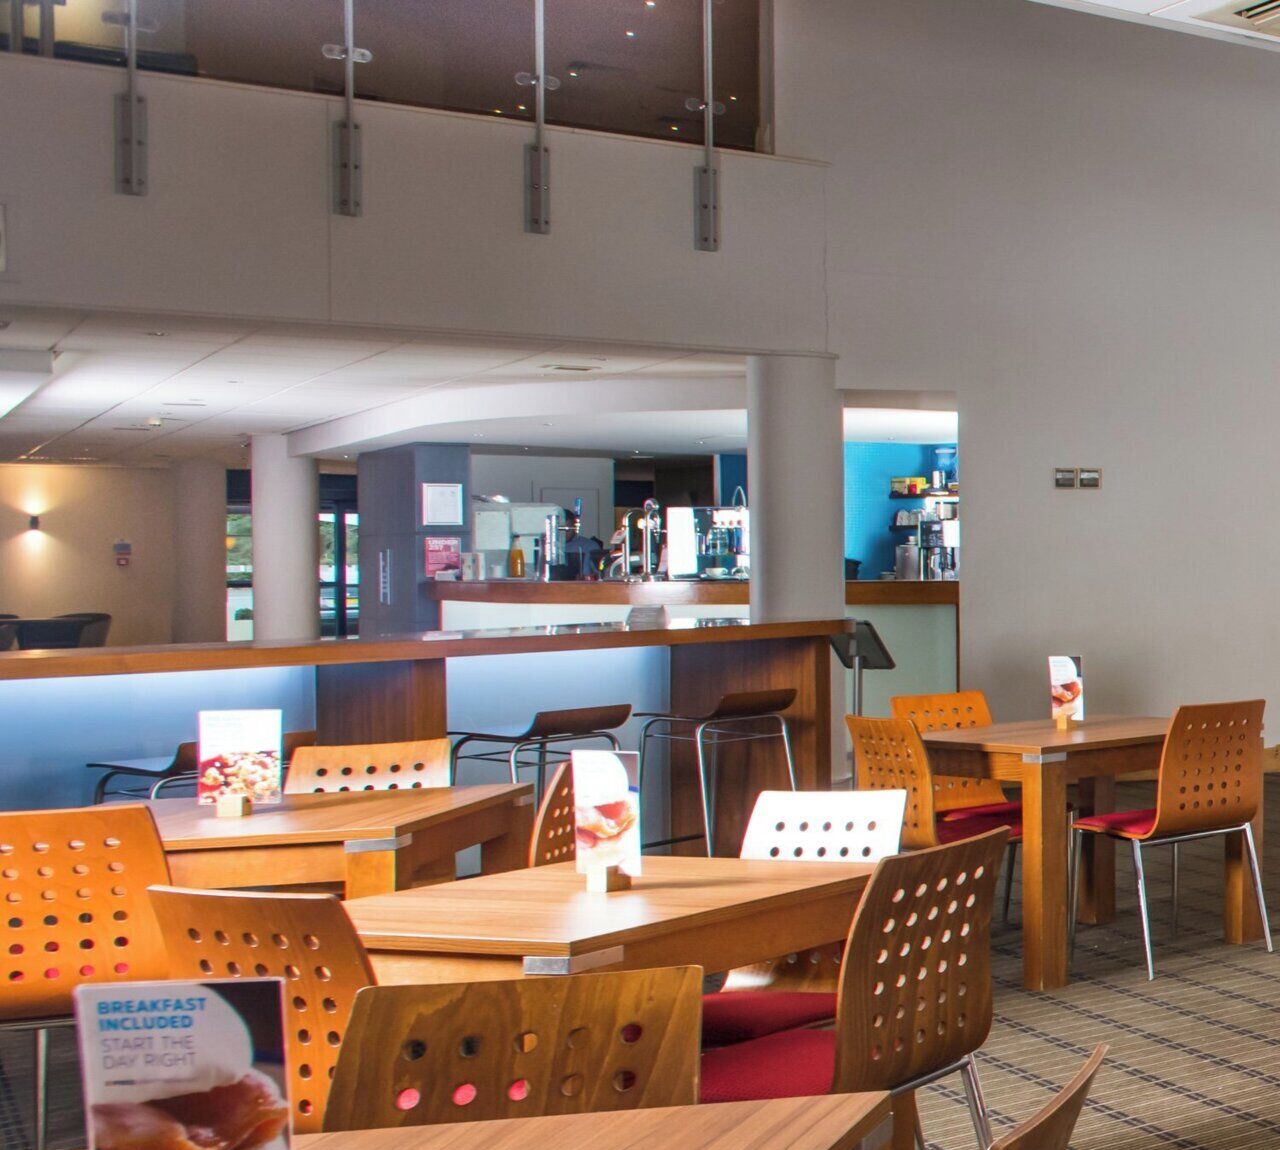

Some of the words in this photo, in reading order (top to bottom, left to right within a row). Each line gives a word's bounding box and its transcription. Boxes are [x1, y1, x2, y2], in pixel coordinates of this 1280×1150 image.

[97, 997, 207, 1014] BREAKFAST
[98, 1015, 193, 1031] INCLUDED
[102, 1037, 154, 1053] START
[160, 1035, 194, 1049] THE
[102, 1055, 136, 1070] DAY
[144, 1052, 196, 1067] RIGHT
